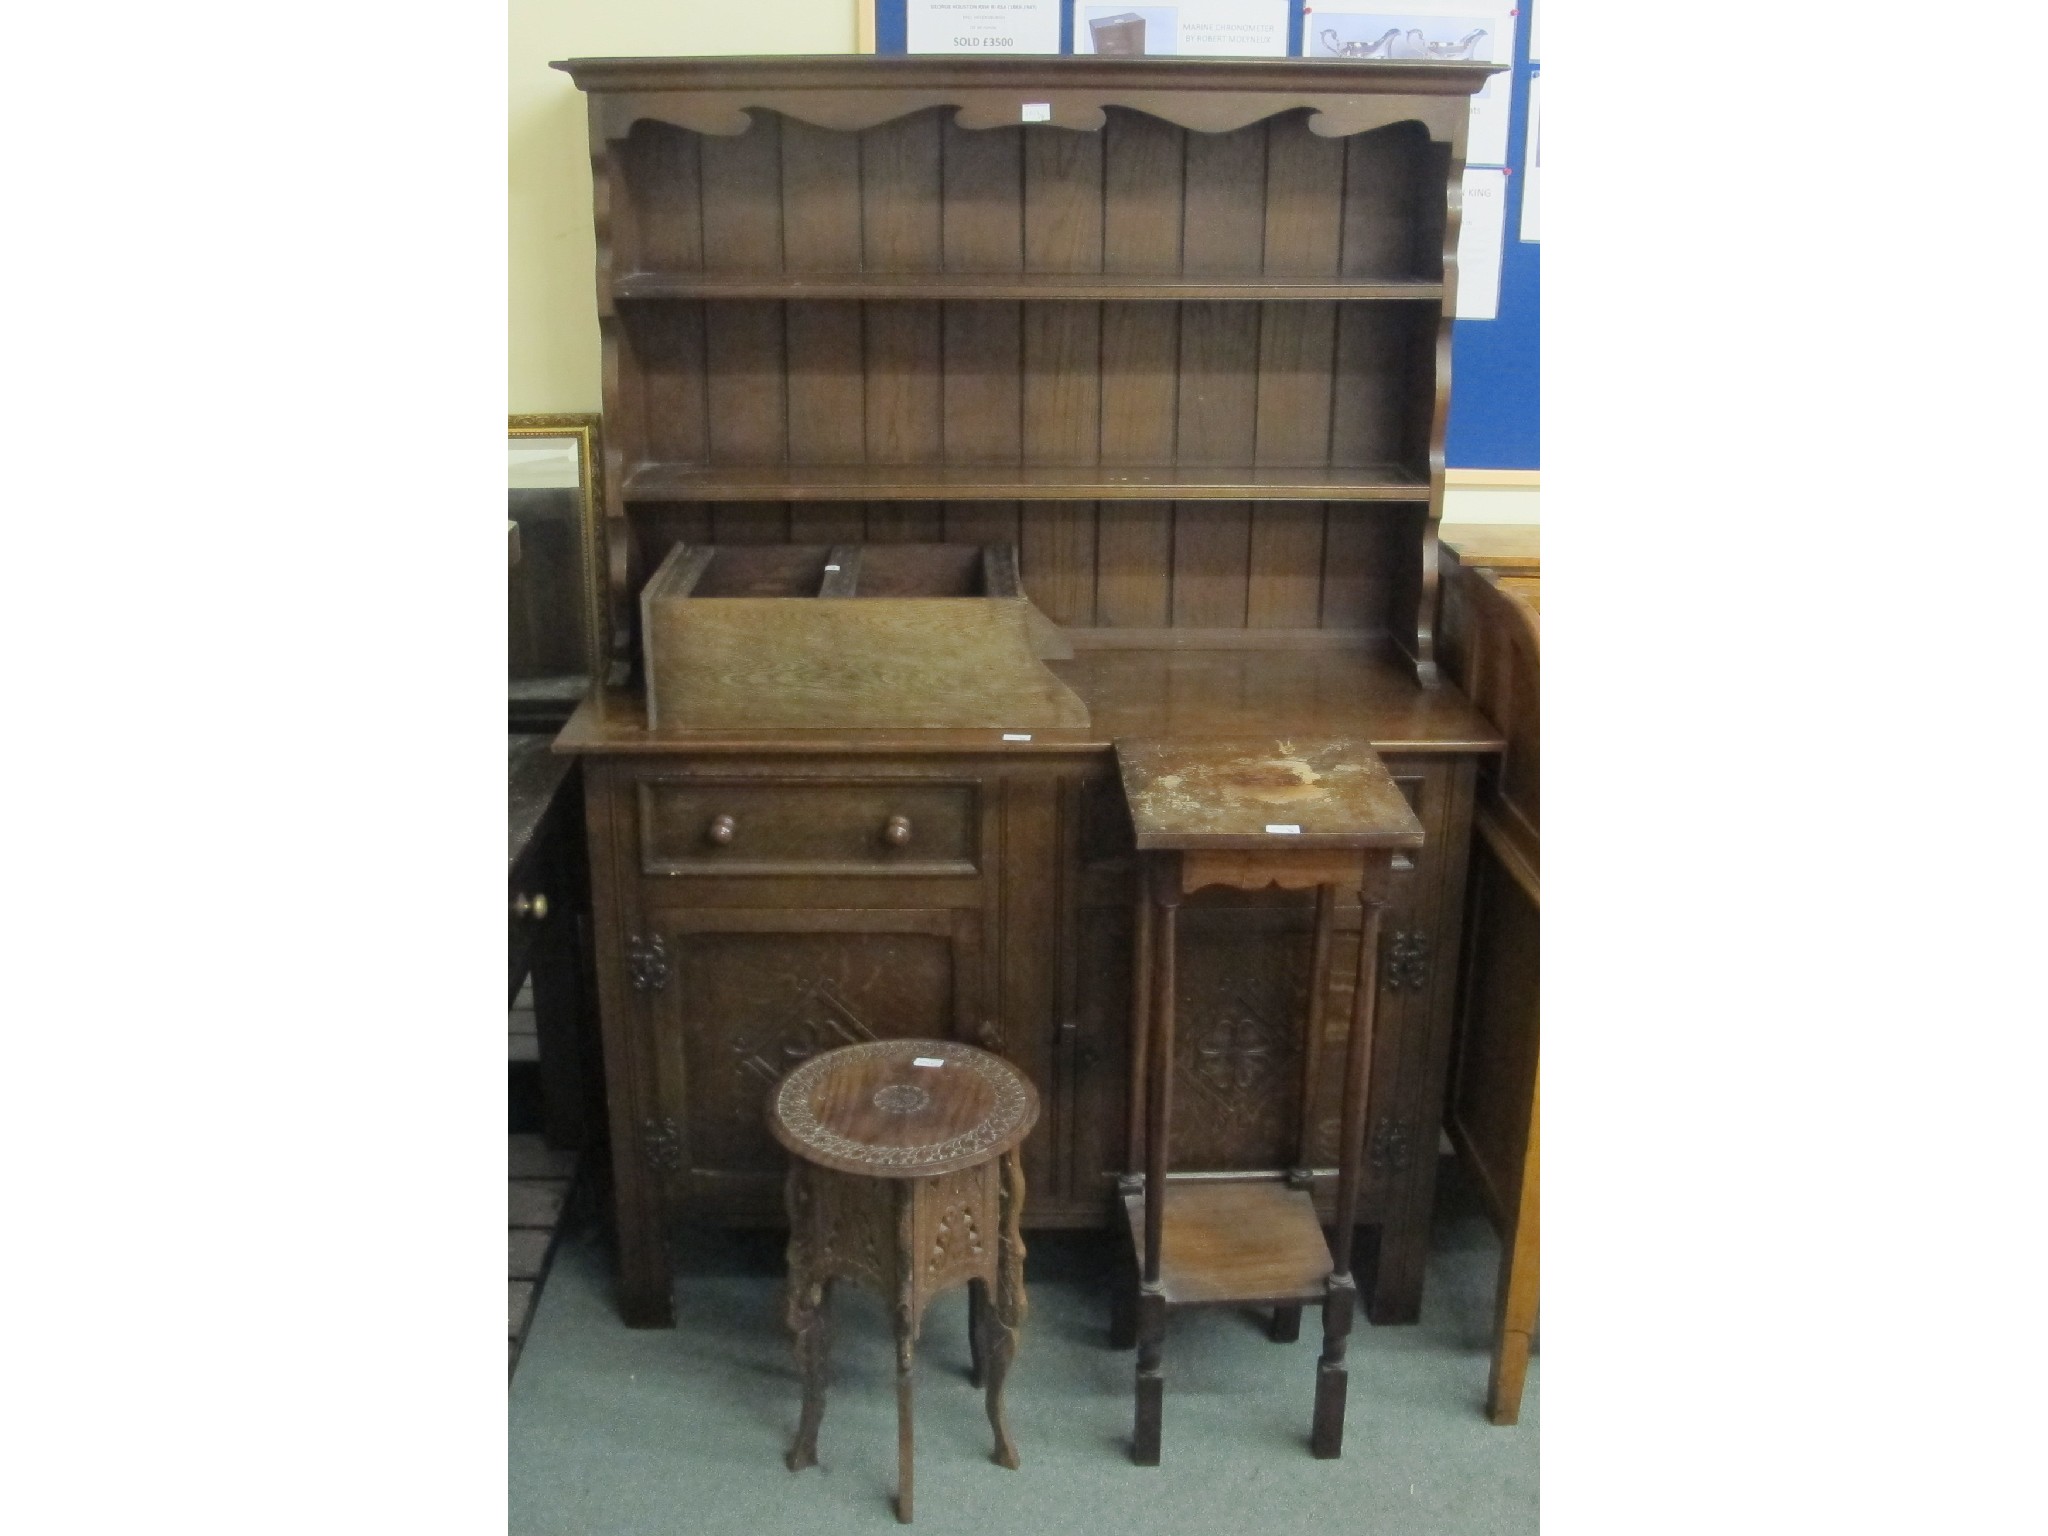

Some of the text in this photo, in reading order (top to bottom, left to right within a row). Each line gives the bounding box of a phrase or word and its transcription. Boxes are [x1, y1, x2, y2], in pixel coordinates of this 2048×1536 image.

[1182, 23, 1275, 32] MARINE CHRONOMETER
[953, 37, 1014, 47] SOLD £3500
[1197, 35, 1226, 43] ROBERT
[1469, 188, 1492, 198] KING
